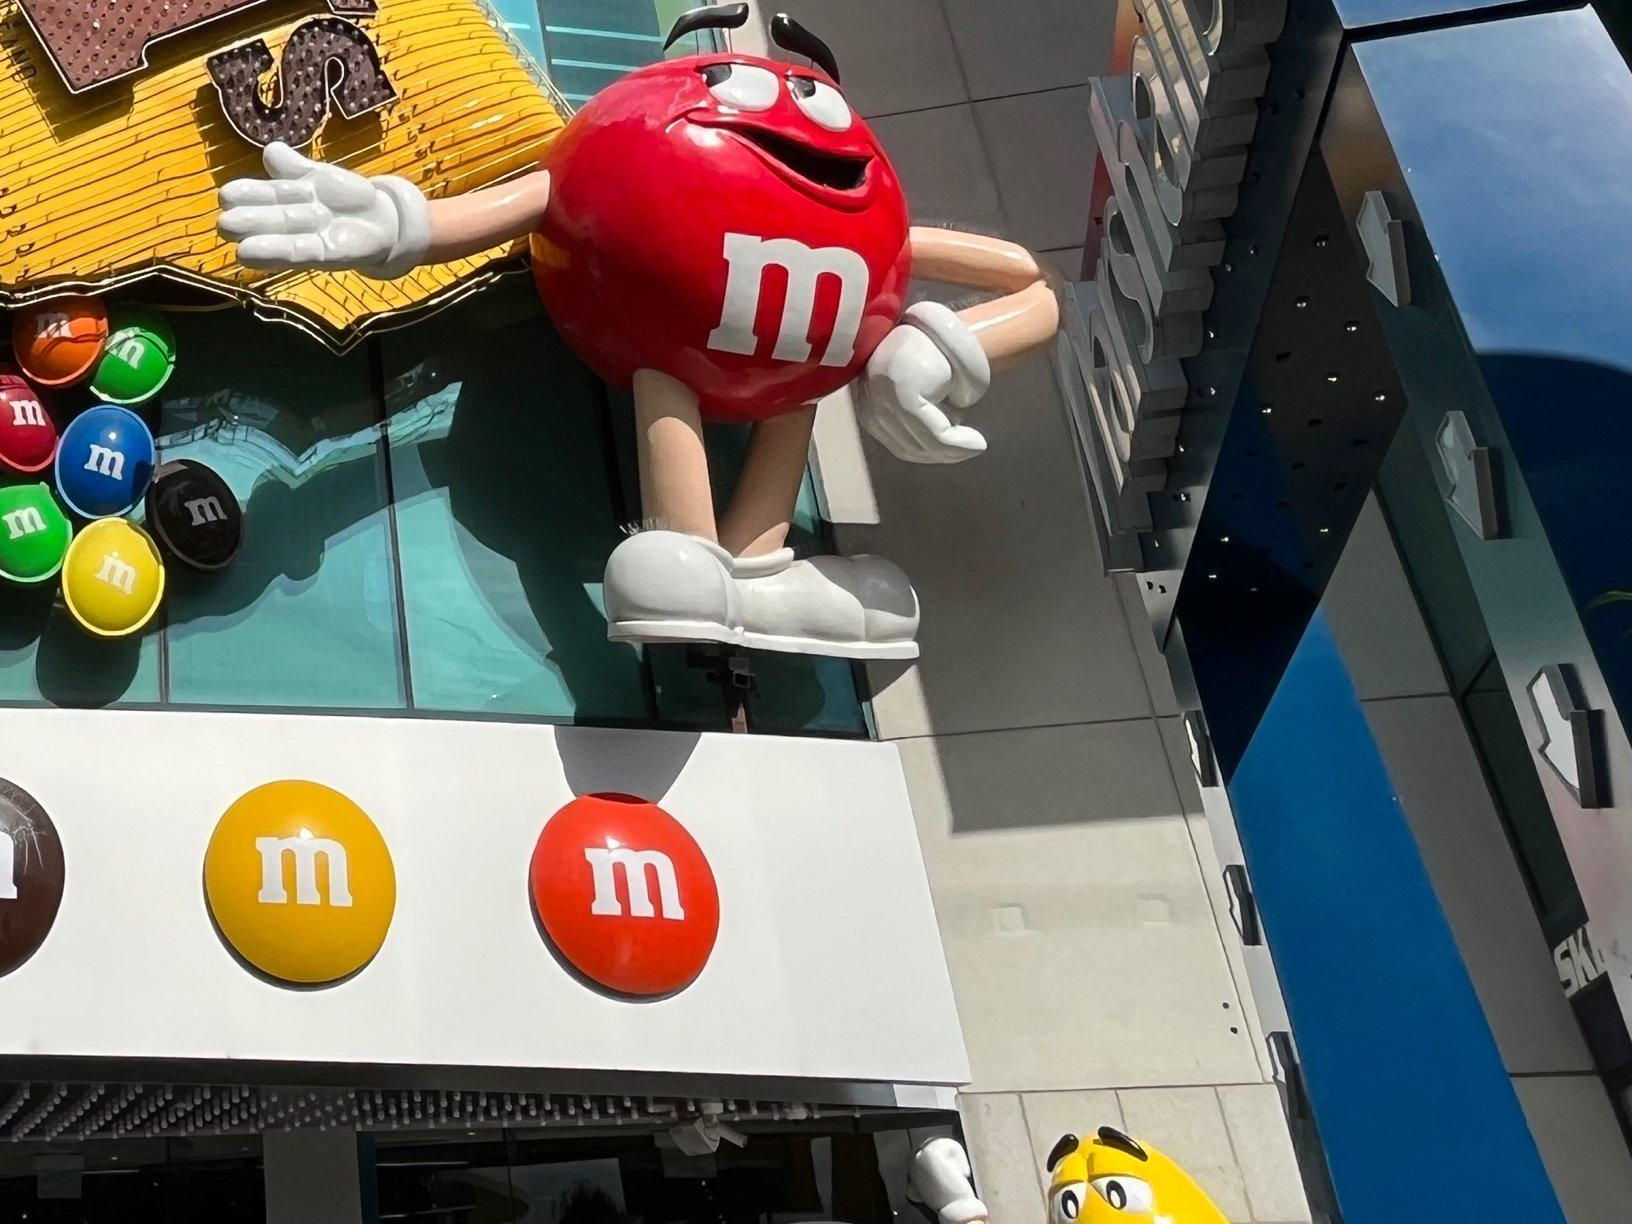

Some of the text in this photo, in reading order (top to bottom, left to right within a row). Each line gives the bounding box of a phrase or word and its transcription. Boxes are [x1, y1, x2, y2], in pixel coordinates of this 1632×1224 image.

[707, 231, 870, 368] m
[9, 398, 46, 426] m
[86, 440, 126, 482] m
[1, 505, 47, 541] m
[184, 493, 228, 527] m
[94, 551, 136, 595] m
[255, 834, 354, 908] m
[584, 846, 686, 922] m
